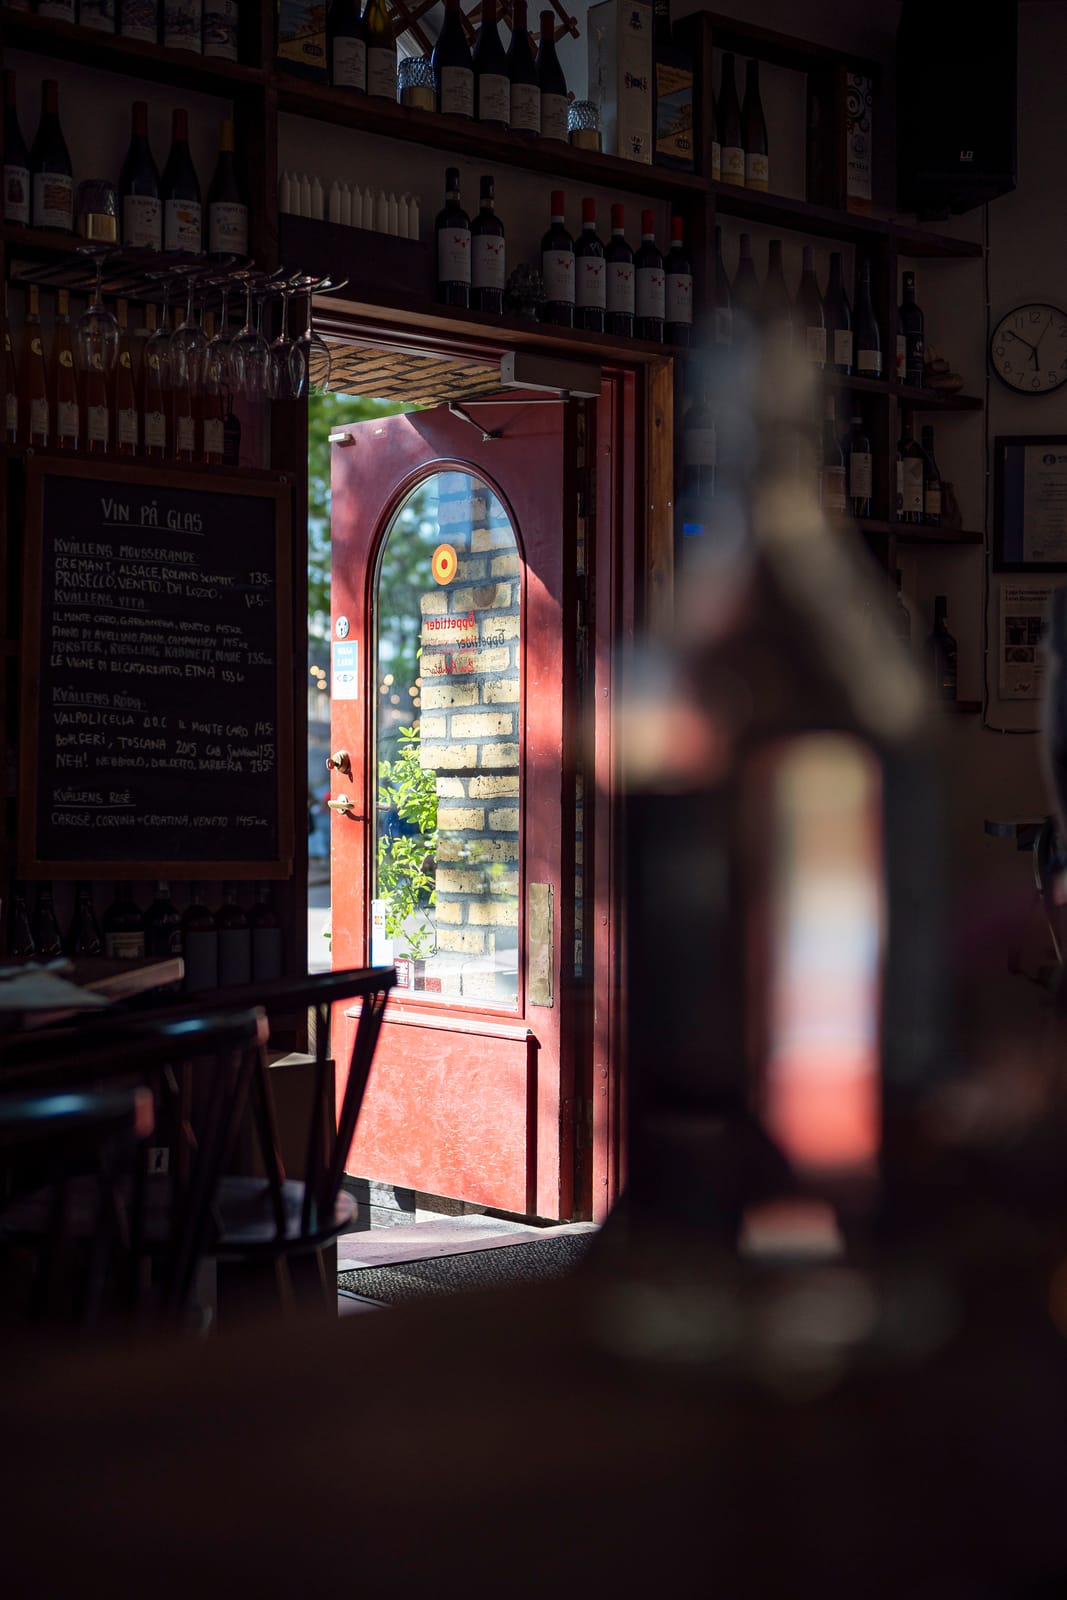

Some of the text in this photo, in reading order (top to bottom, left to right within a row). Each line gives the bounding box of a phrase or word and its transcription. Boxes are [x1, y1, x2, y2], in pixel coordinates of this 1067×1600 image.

[1015, 316, 1024, 329] 11
[1029, 312, 1040, 324] 12
[1003, 361, 1013, 374] 8
[1015, 371, 1025, 385] 7
[1031, 375, 1041, 389] 6
[1047, 370, 1058, 385] 5
[100, 497, 203, 533] VIN PÅ GLAS
[185, 664, 216, 680] ETNA
[55, 751, 89, 769] NEH!
